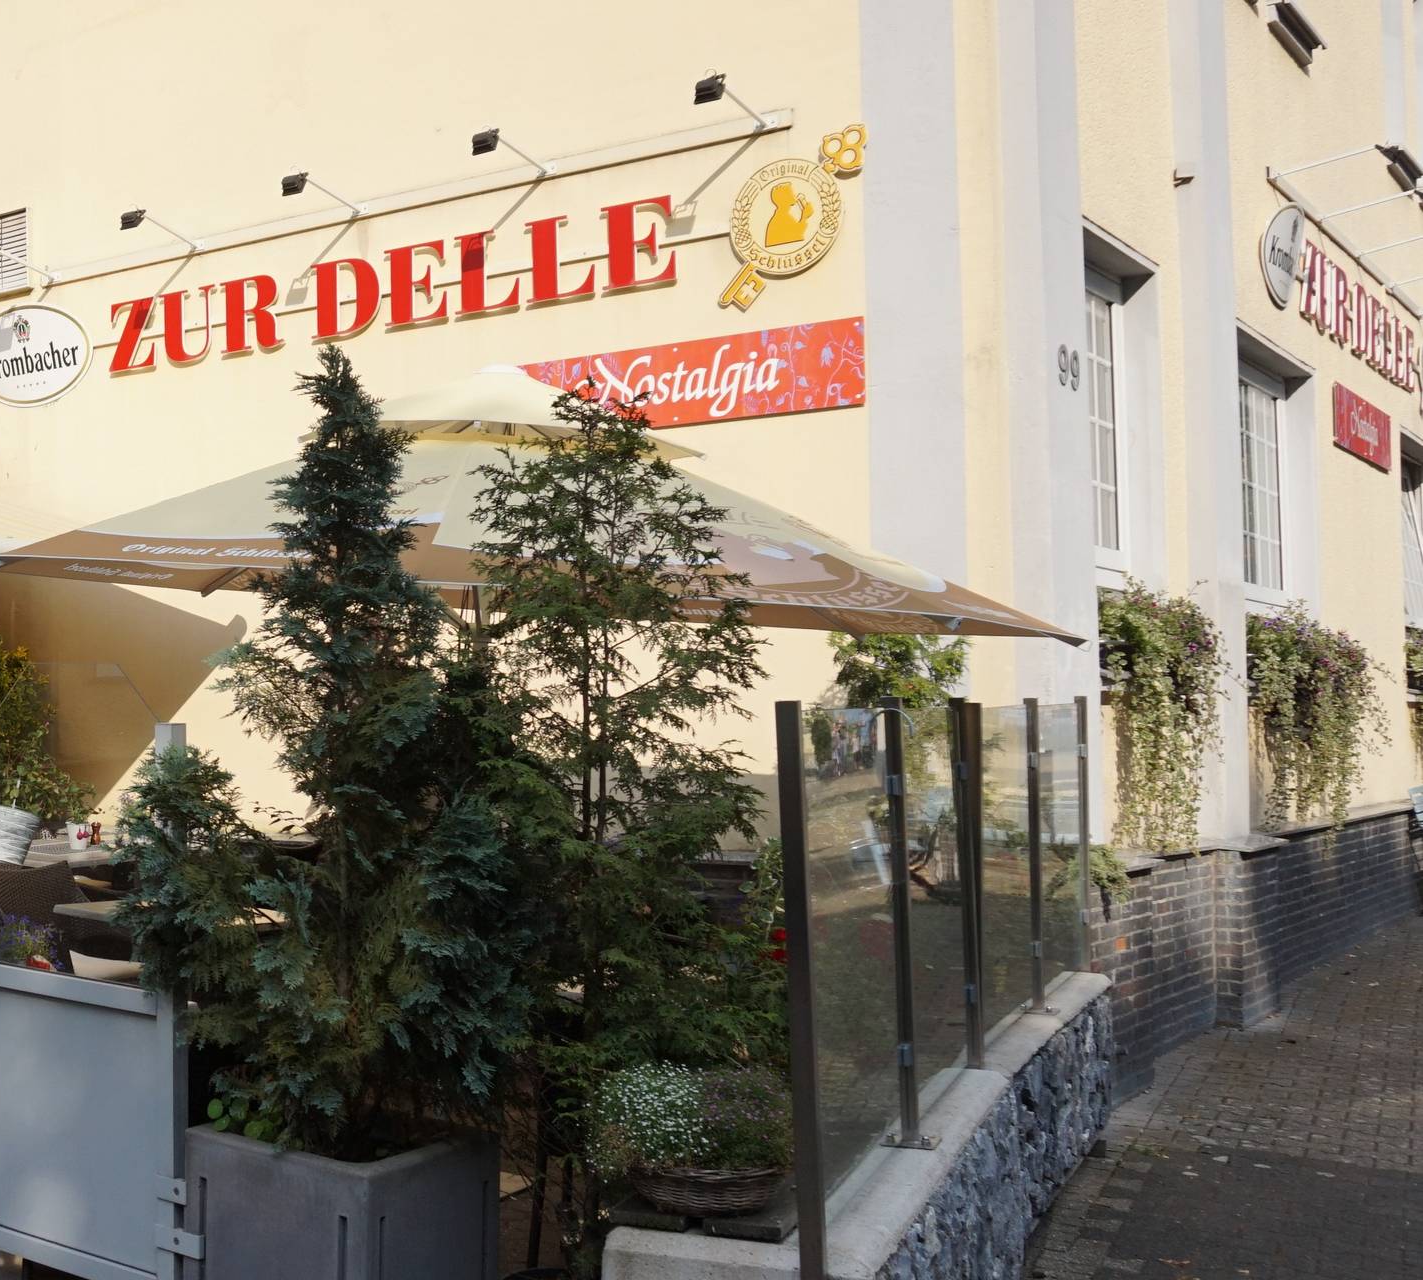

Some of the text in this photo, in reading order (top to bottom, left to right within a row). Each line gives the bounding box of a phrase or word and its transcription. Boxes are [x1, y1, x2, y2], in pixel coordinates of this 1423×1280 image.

[758, 160, 809, 183] Original
[748, 238, 826, 270] Schlüssel
[109, 195, 678, 373] ZUR DELLE
[575, 343, 781, 418] Nostalgia
[1057, 343, 1080, 391] 99
[122, 543, 217, 557] Original
